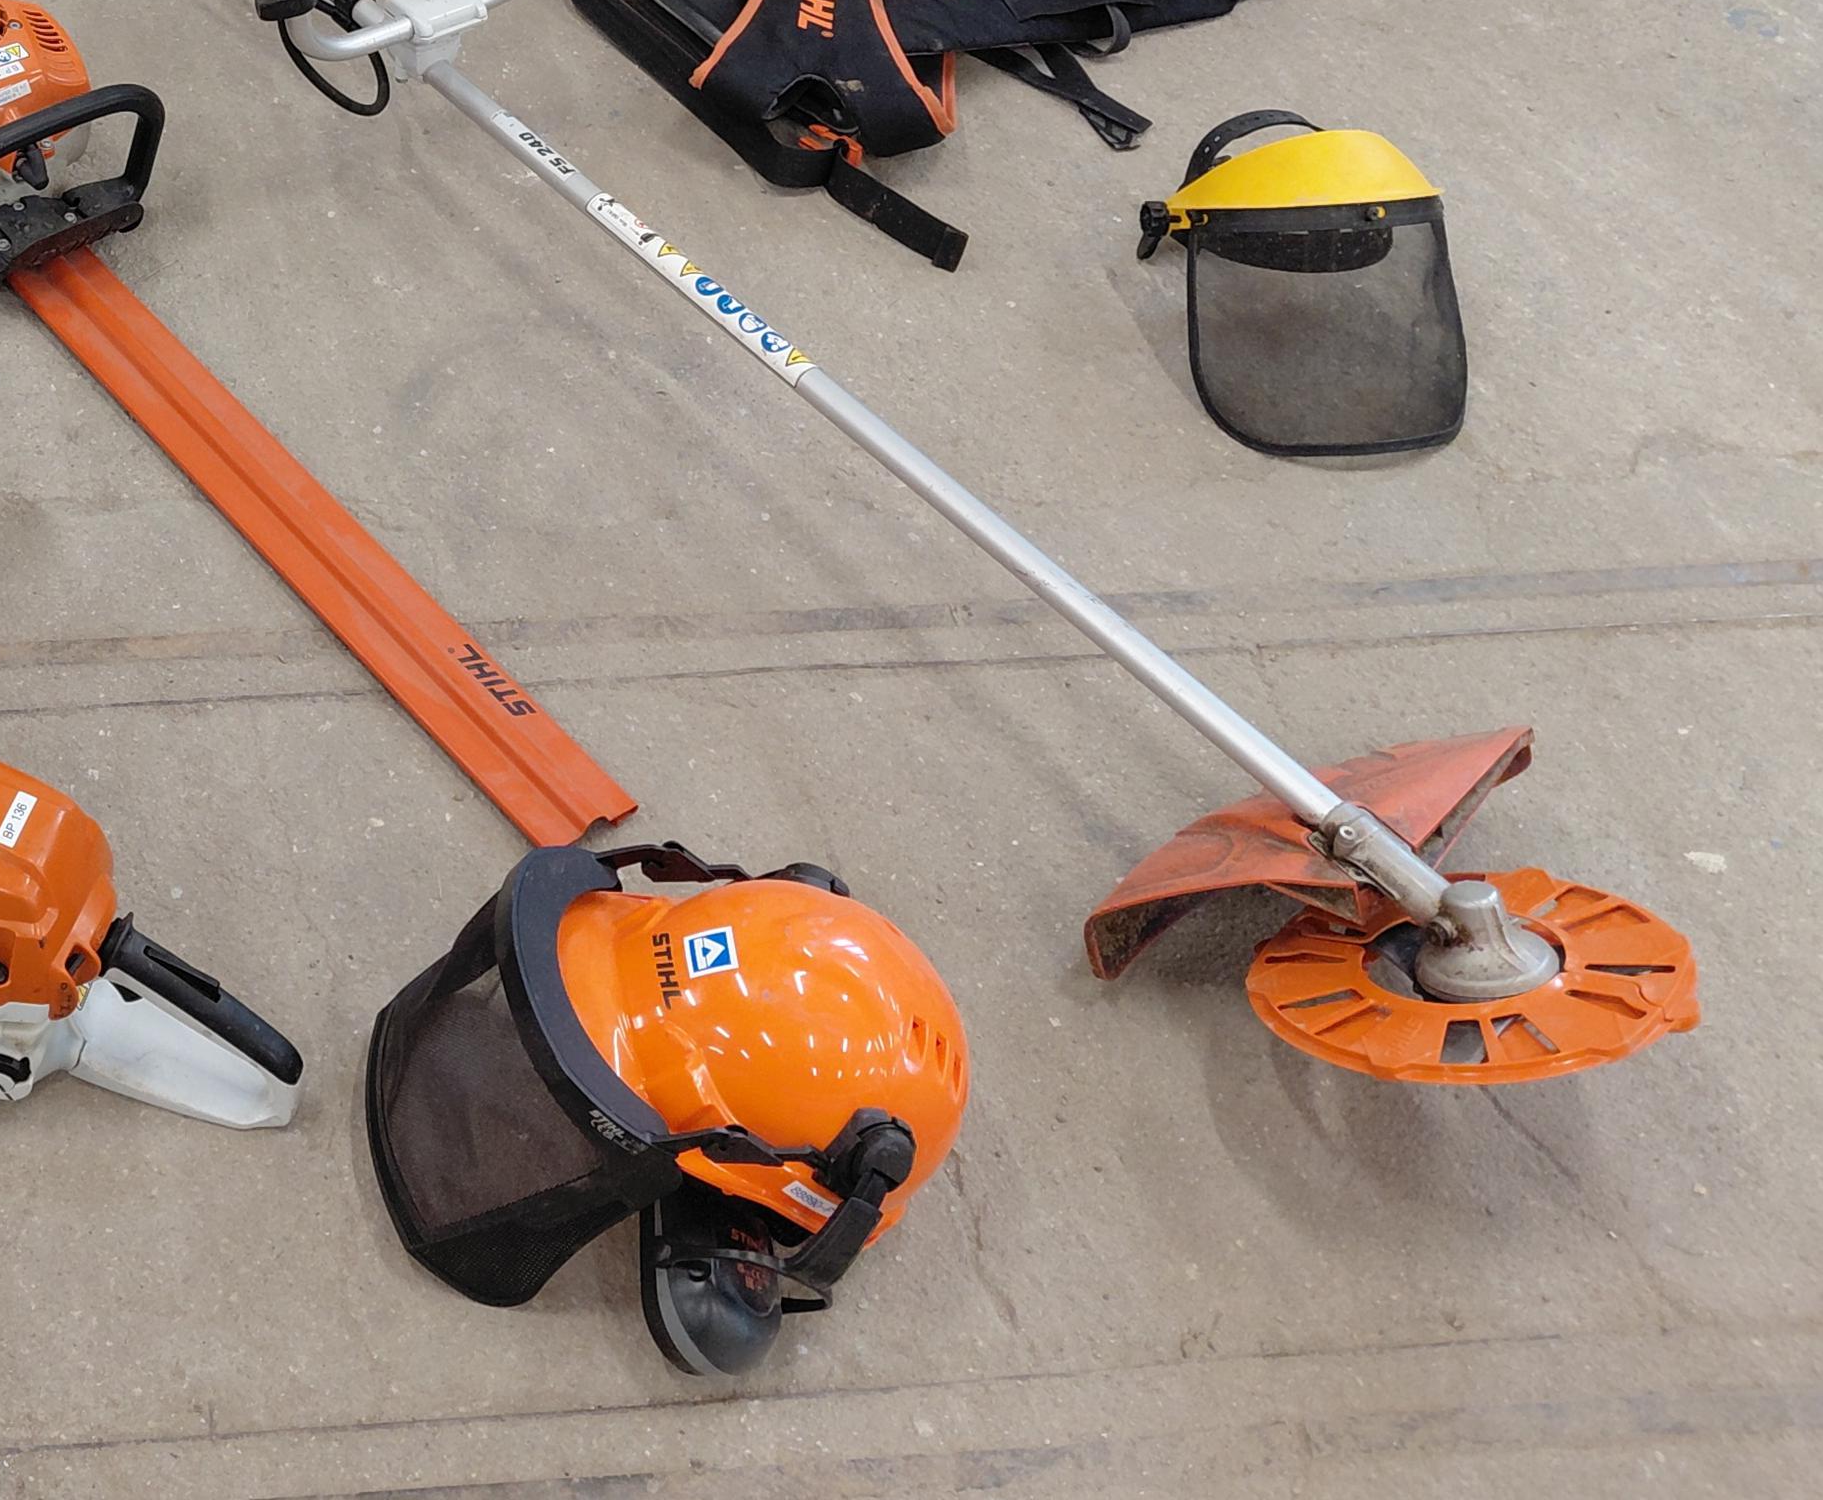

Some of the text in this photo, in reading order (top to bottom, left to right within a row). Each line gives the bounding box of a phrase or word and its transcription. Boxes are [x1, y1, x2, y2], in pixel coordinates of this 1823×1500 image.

[519, 132, 575, 175] FS 240
[457, 643, 537, 717] STIHL
[3, 802, 28, 840] BP 136
[652, 932, 682, 1010] STIHL
